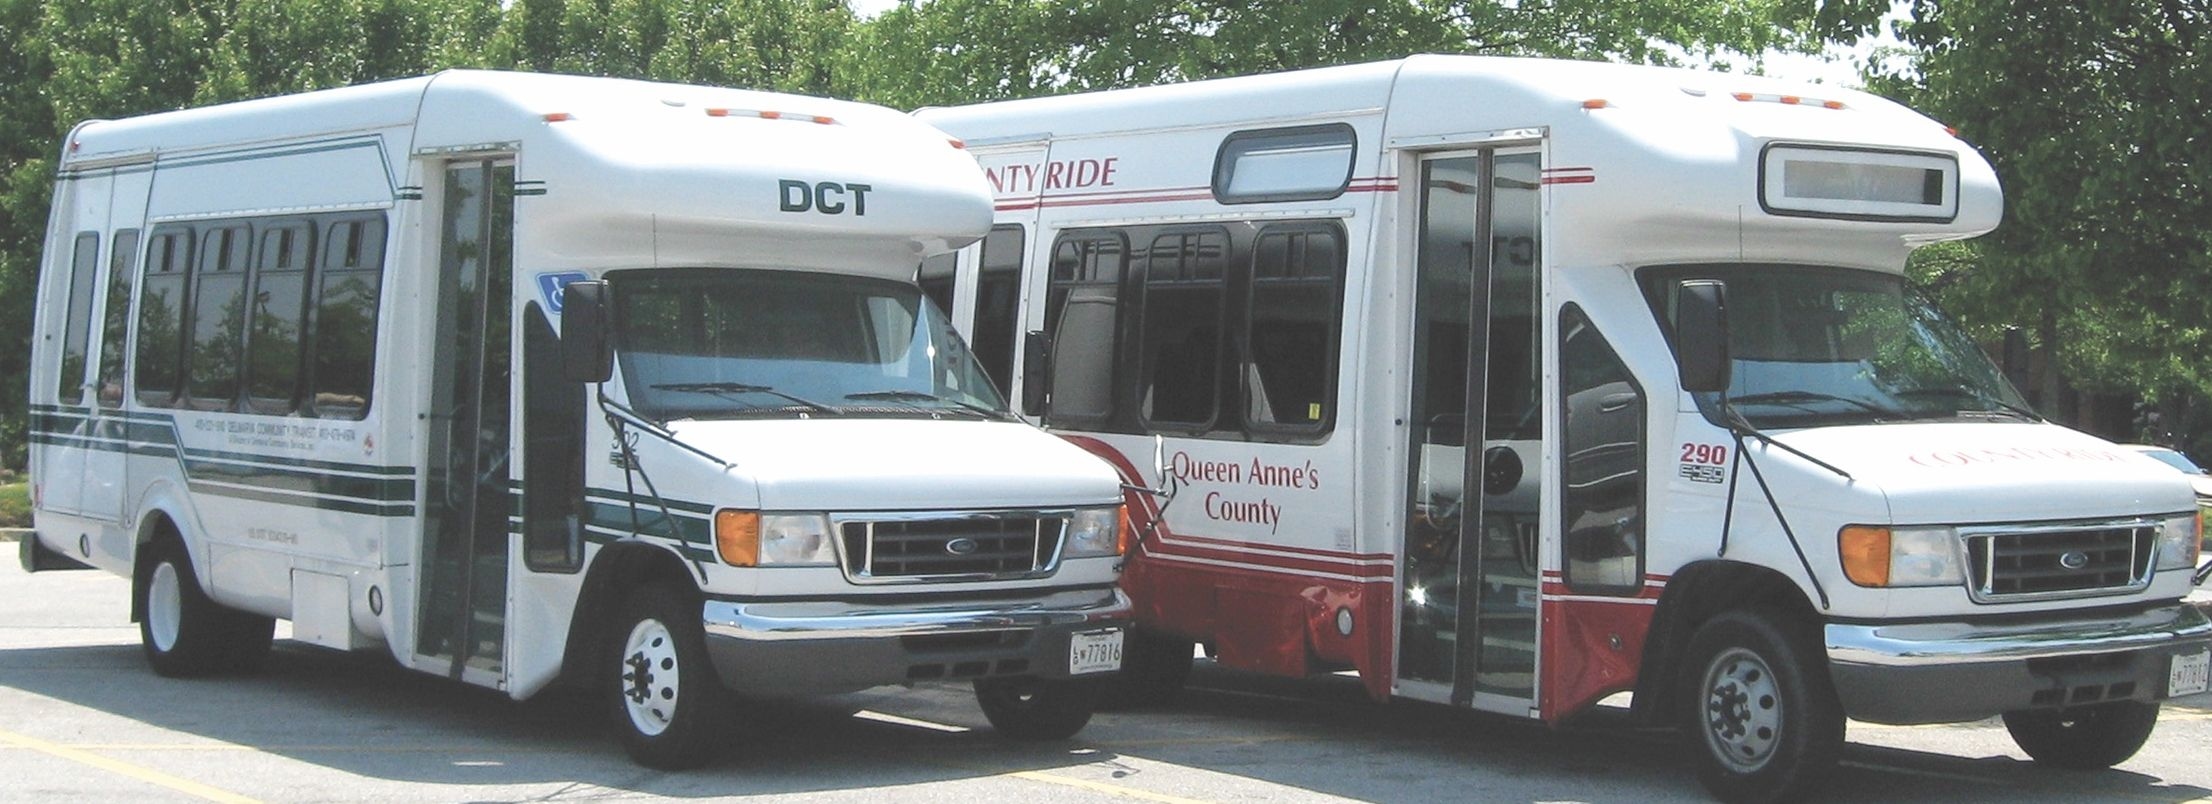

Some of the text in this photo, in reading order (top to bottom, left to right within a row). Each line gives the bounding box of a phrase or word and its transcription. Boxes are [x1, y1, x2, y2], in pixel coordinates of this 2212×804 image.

[985, 157, 1118, 193] NTY RIDE
[778, 178, 872, 216] DCT
[1172, 451, 1319, 490] Queen Anne's
[1680, 443, 1726, 465] 290
[1205, 491, 1281, 535] County
[1087, 643, 1121, 663] 77816
